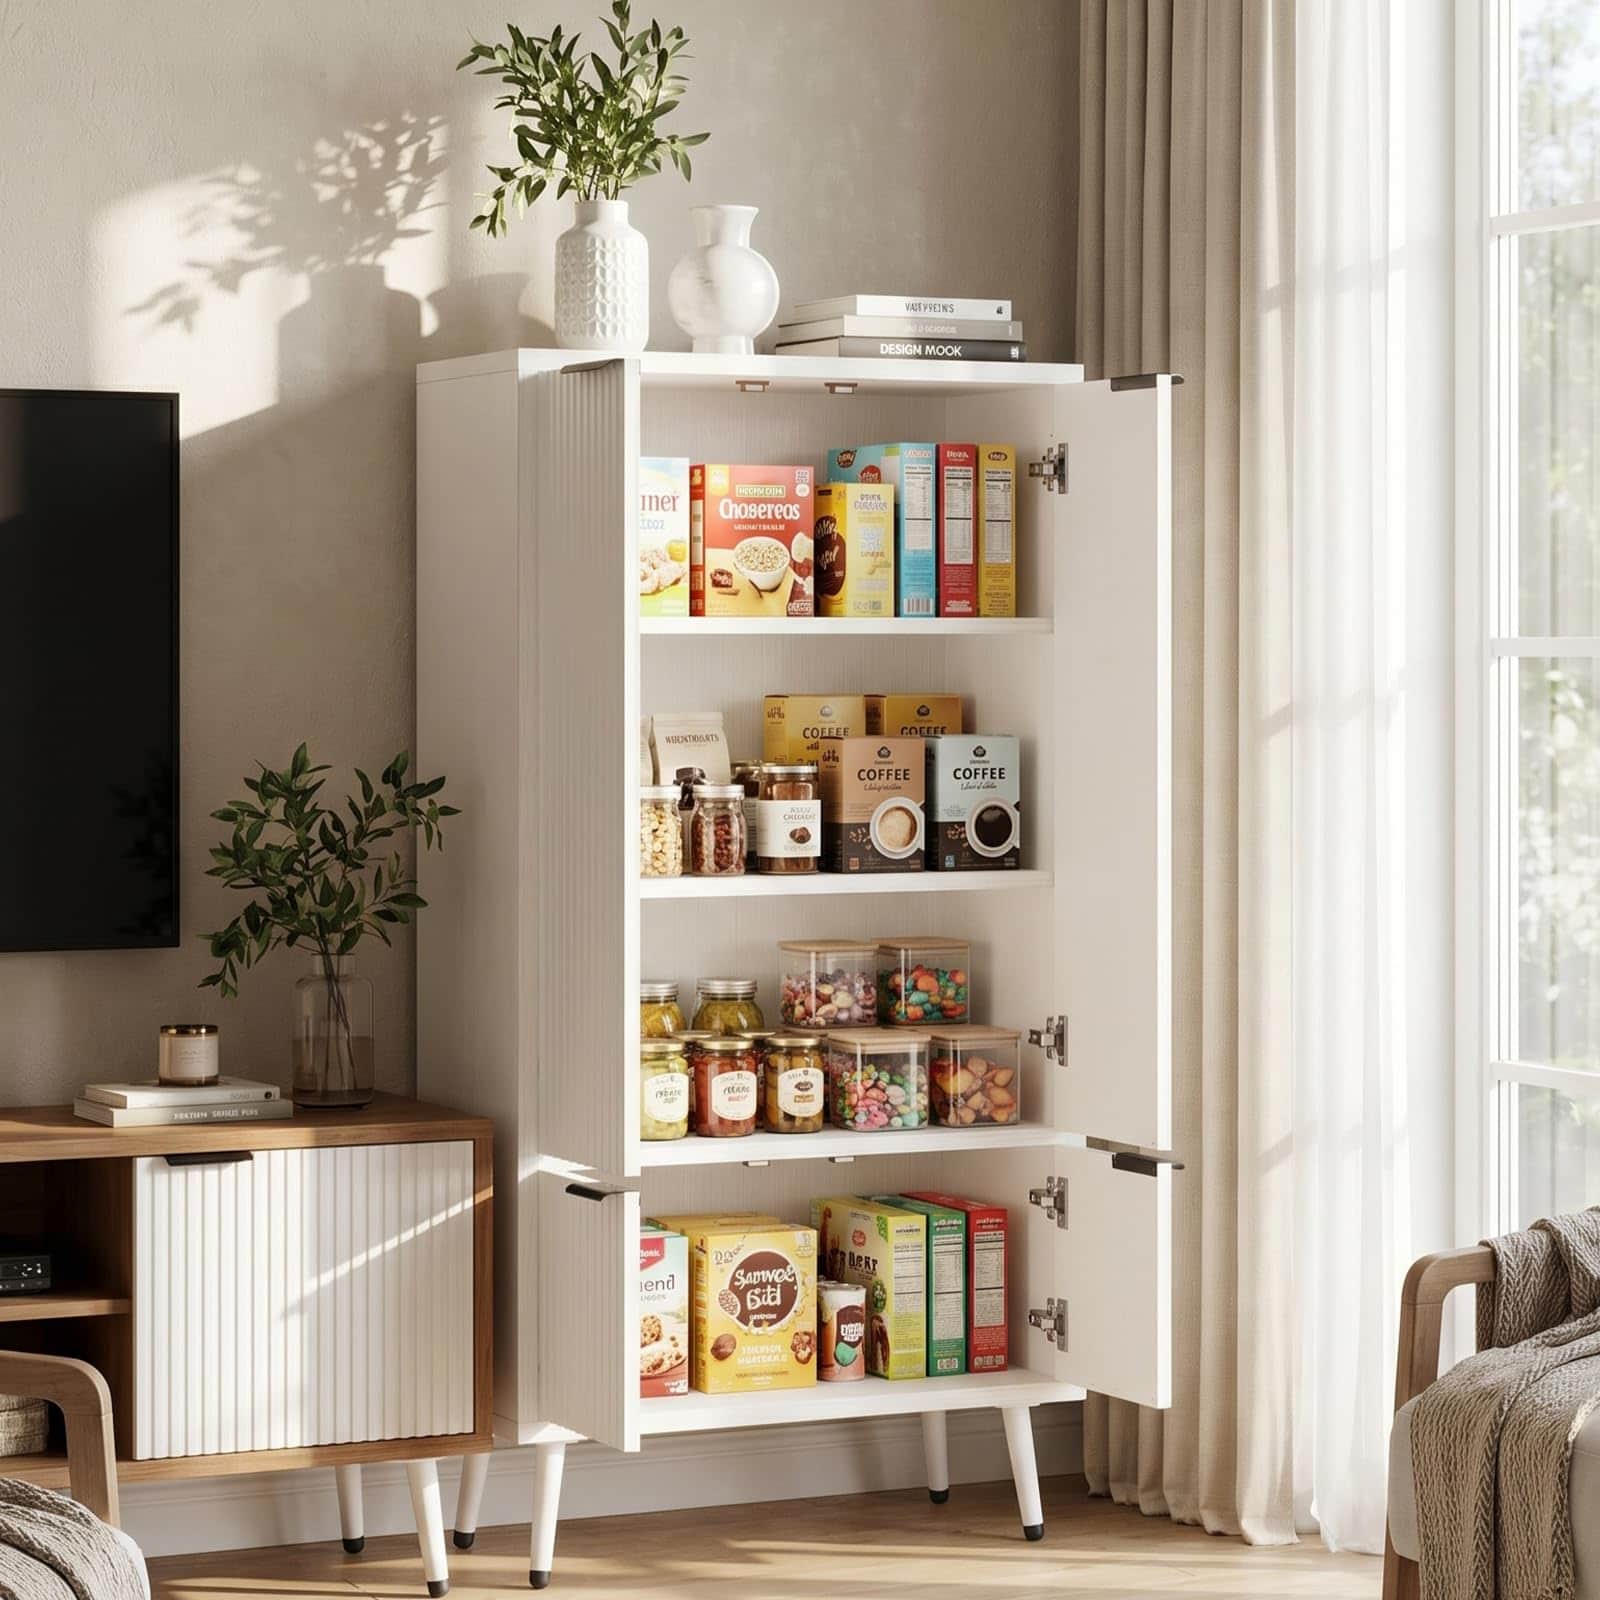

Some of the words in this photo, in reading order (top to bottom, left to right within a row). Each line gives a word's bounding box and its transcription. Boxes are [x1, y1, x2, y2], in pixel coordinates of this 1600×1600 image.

[880, 343, 922, 356] DESIGN
[925, 344, 962, 357] MOOK
[857, 768, 911, 781] COFFEE
[952, 767, 1006, 780] COFFEE
